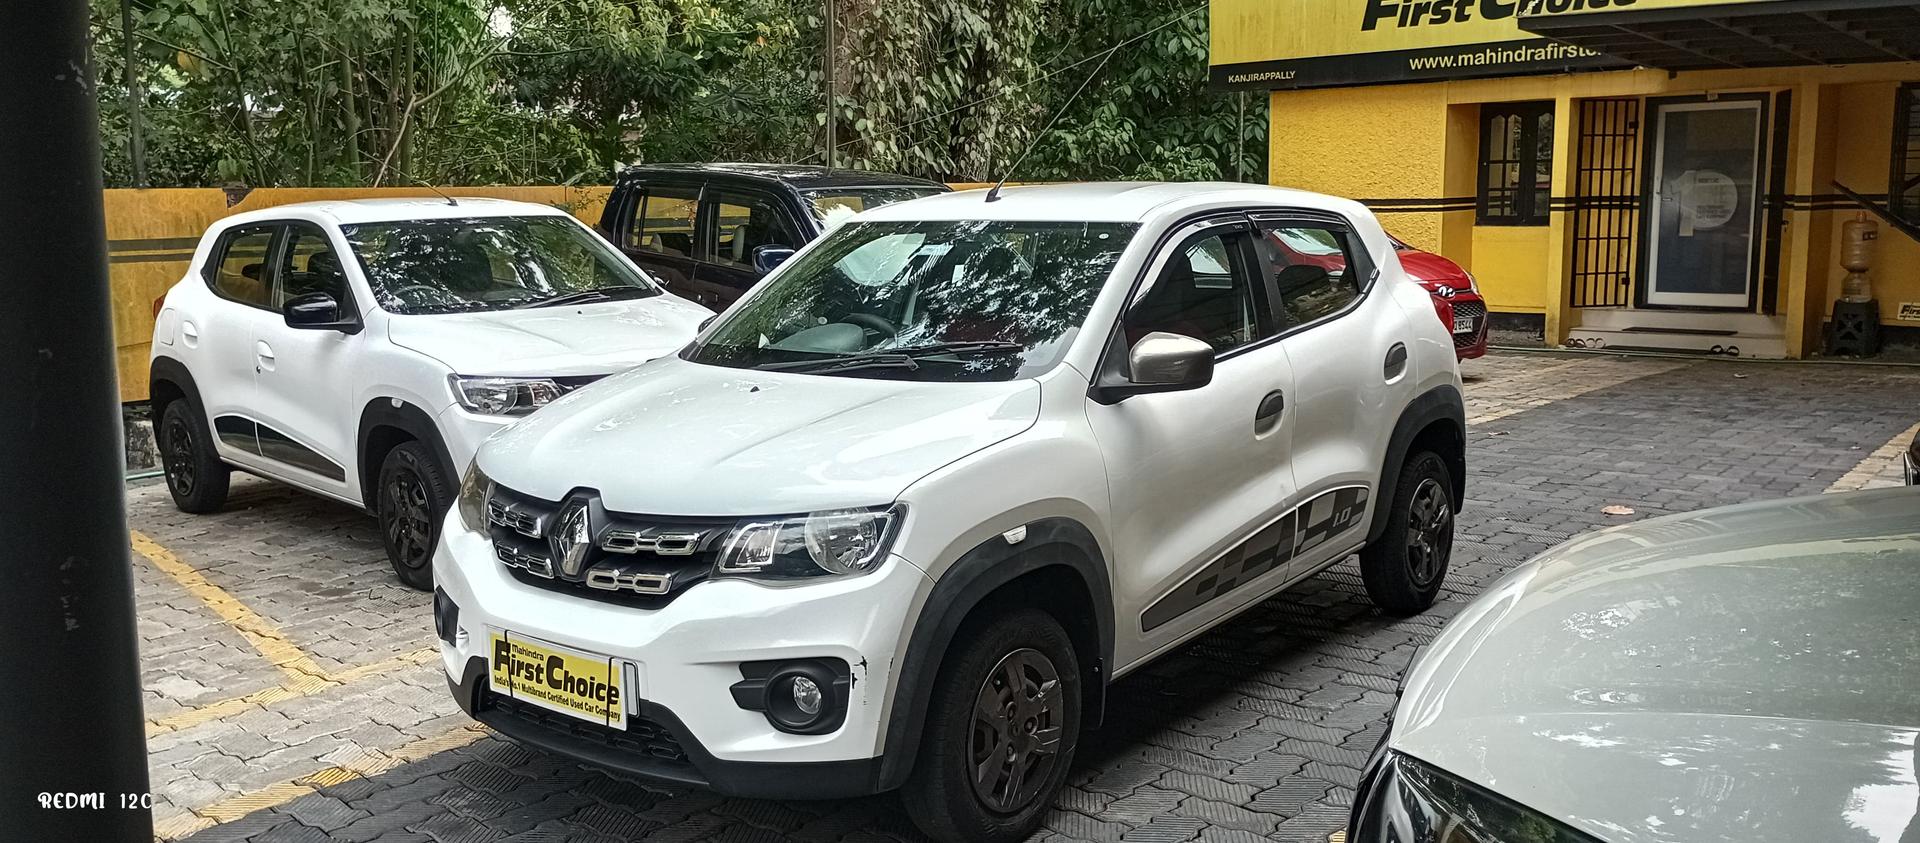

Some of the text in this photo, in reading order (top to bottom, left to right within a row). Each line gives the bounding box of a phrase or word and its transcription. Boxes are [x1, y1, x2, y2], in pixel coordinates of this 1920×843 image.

[1409, 43, 1602, 70] www.mahindrafirst
[1228, 71, 1296, 83] KANJIRAPPALLY
[494, 639, 620, 705] First Choice
[521, 683, 547, 699] Multibrand
[547, 691, 569, 706] Certified
[570, 698, 584, 711] Used
[584, 702, 595, 713] Car
